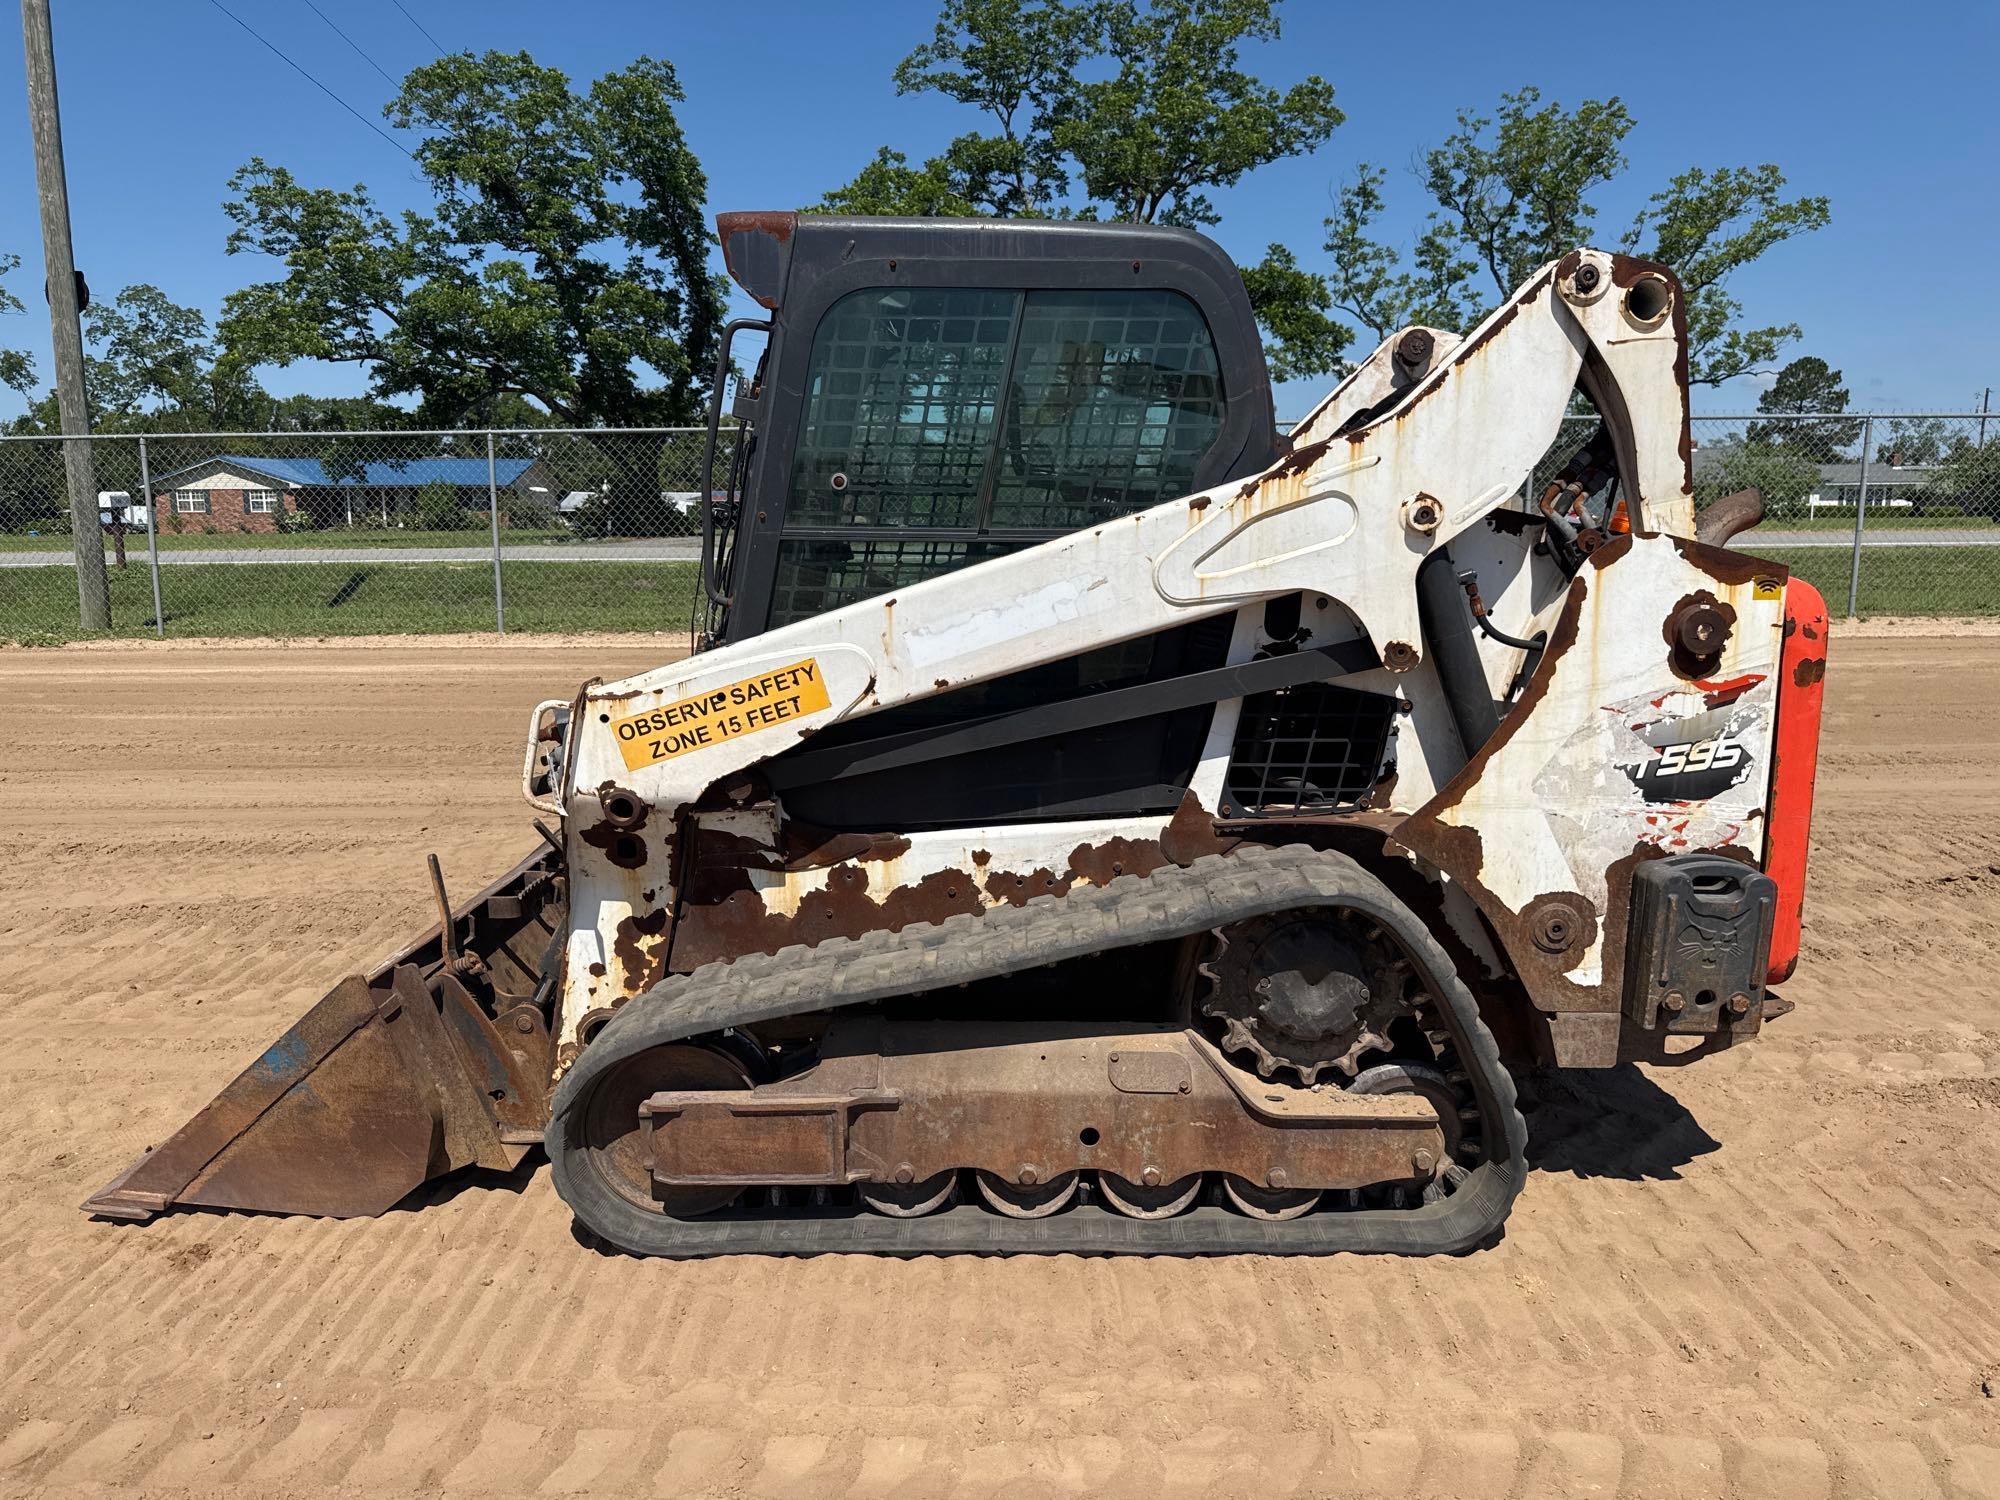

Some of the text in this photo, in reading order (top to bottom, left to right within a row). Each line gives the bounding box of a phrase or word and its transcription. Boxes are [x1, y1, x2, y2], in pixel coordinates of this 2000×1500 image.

[618, 663, 816, 741] OBSERVE SAFETY
[649, 695, 801, 760] ZONE 15 FEET
